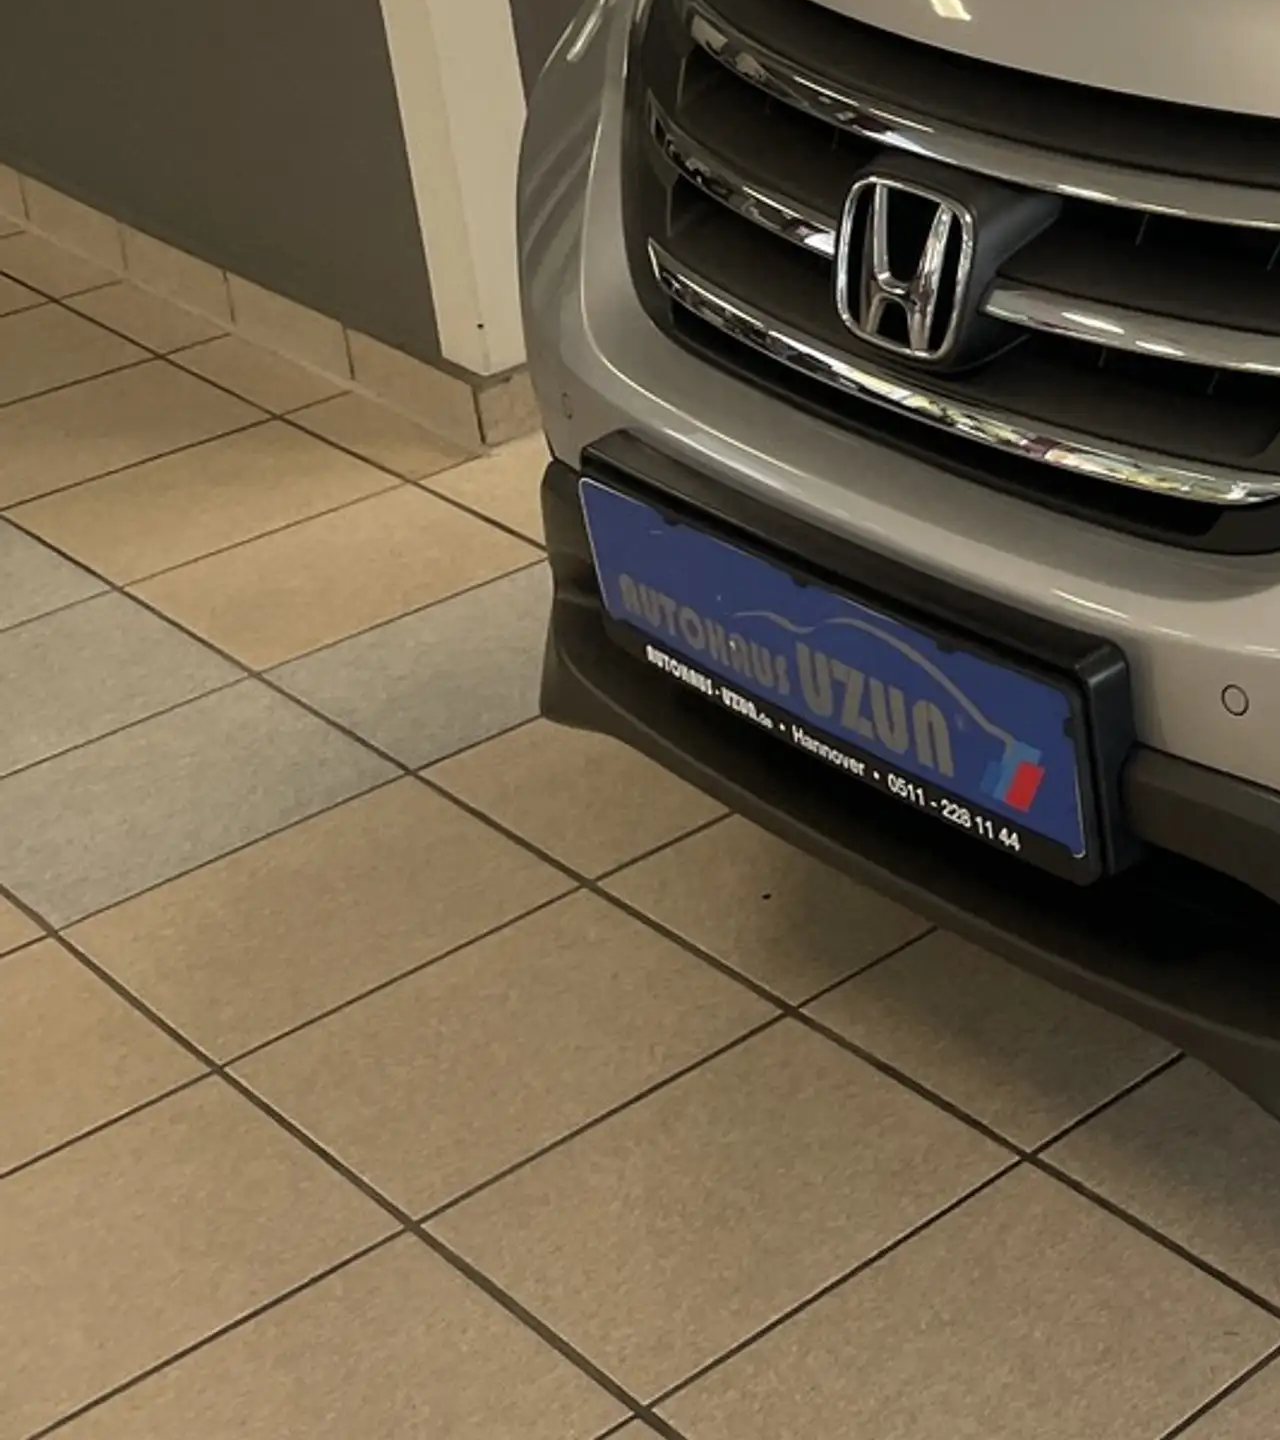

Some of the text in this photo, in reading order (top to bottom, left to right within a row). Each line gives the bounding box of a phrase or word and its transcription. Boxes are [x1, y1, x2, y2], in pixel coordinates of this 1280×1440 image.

[619, 573, 955, 779] AUTOHAUS UZUN
[791, 723, 866, 777] Hannover
[974, 815, 995, 851] 11
[998, 826, 1022, 853] 44
